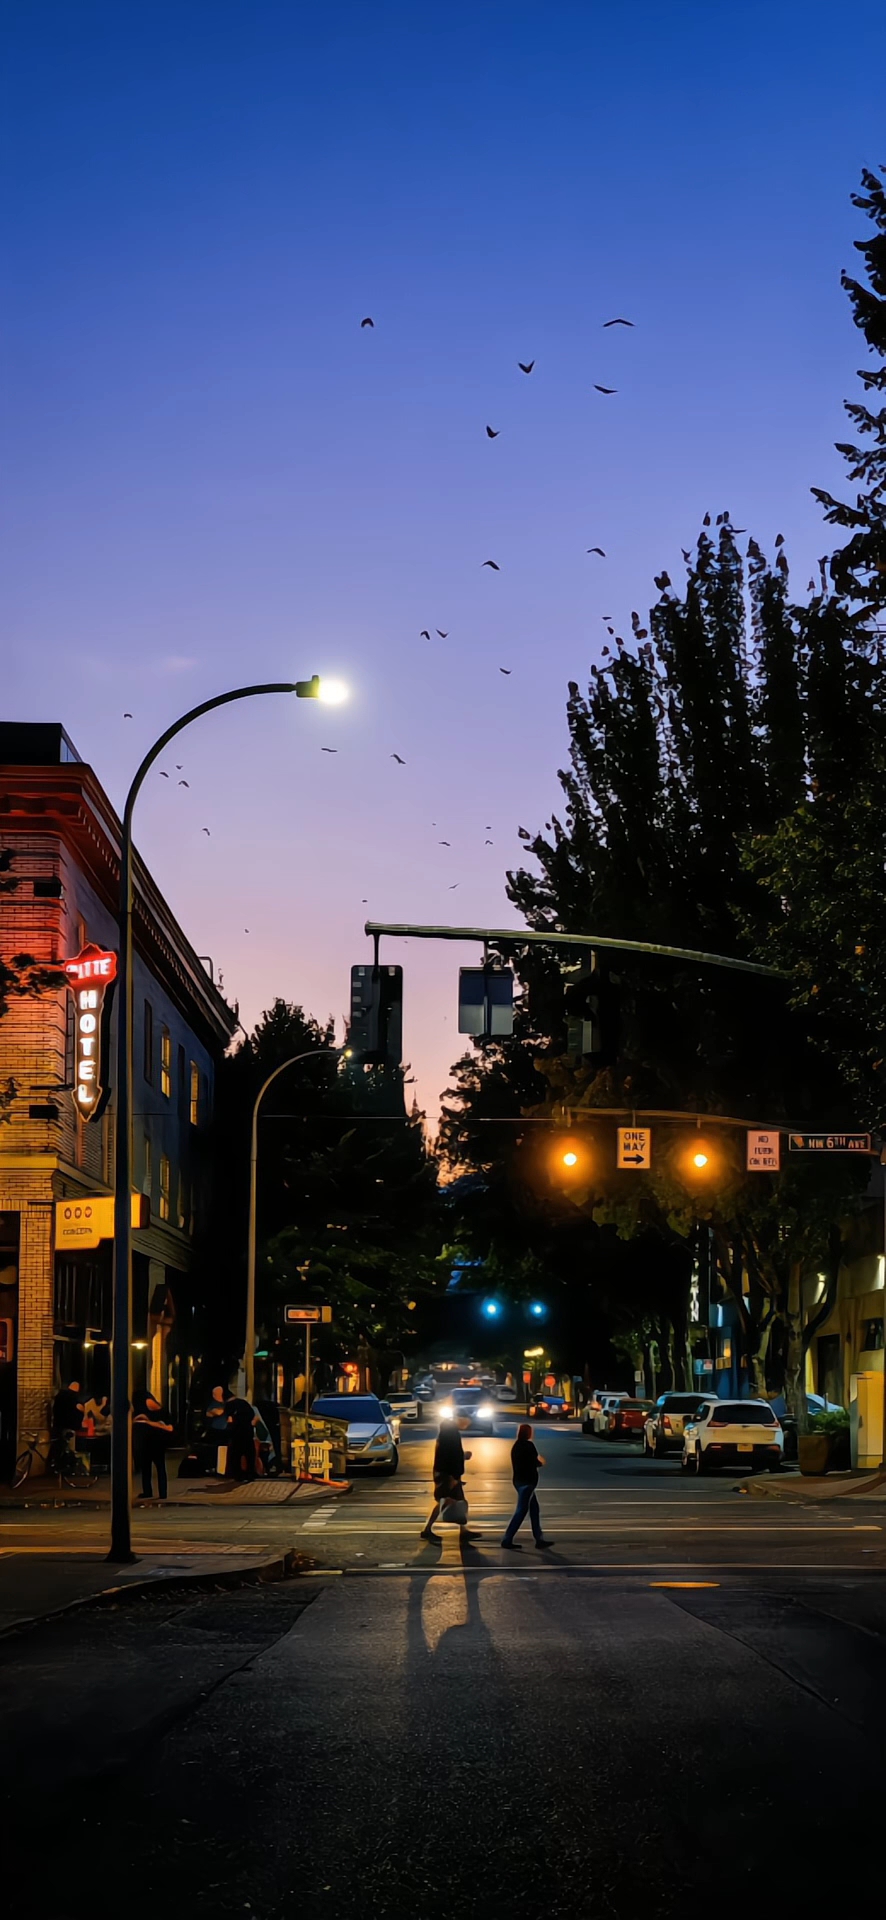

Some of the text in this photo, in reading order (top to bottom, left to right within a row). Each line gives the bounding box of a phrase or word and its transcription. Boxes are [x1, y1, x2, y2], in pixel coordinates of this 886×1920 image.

[78, 989, 97, 1103] HOTEL
[624, 1132, 645, 1141] ONE
[623, 1142, 646, 1151] WAY
[826, 1136, 847, 1149] 6TH
